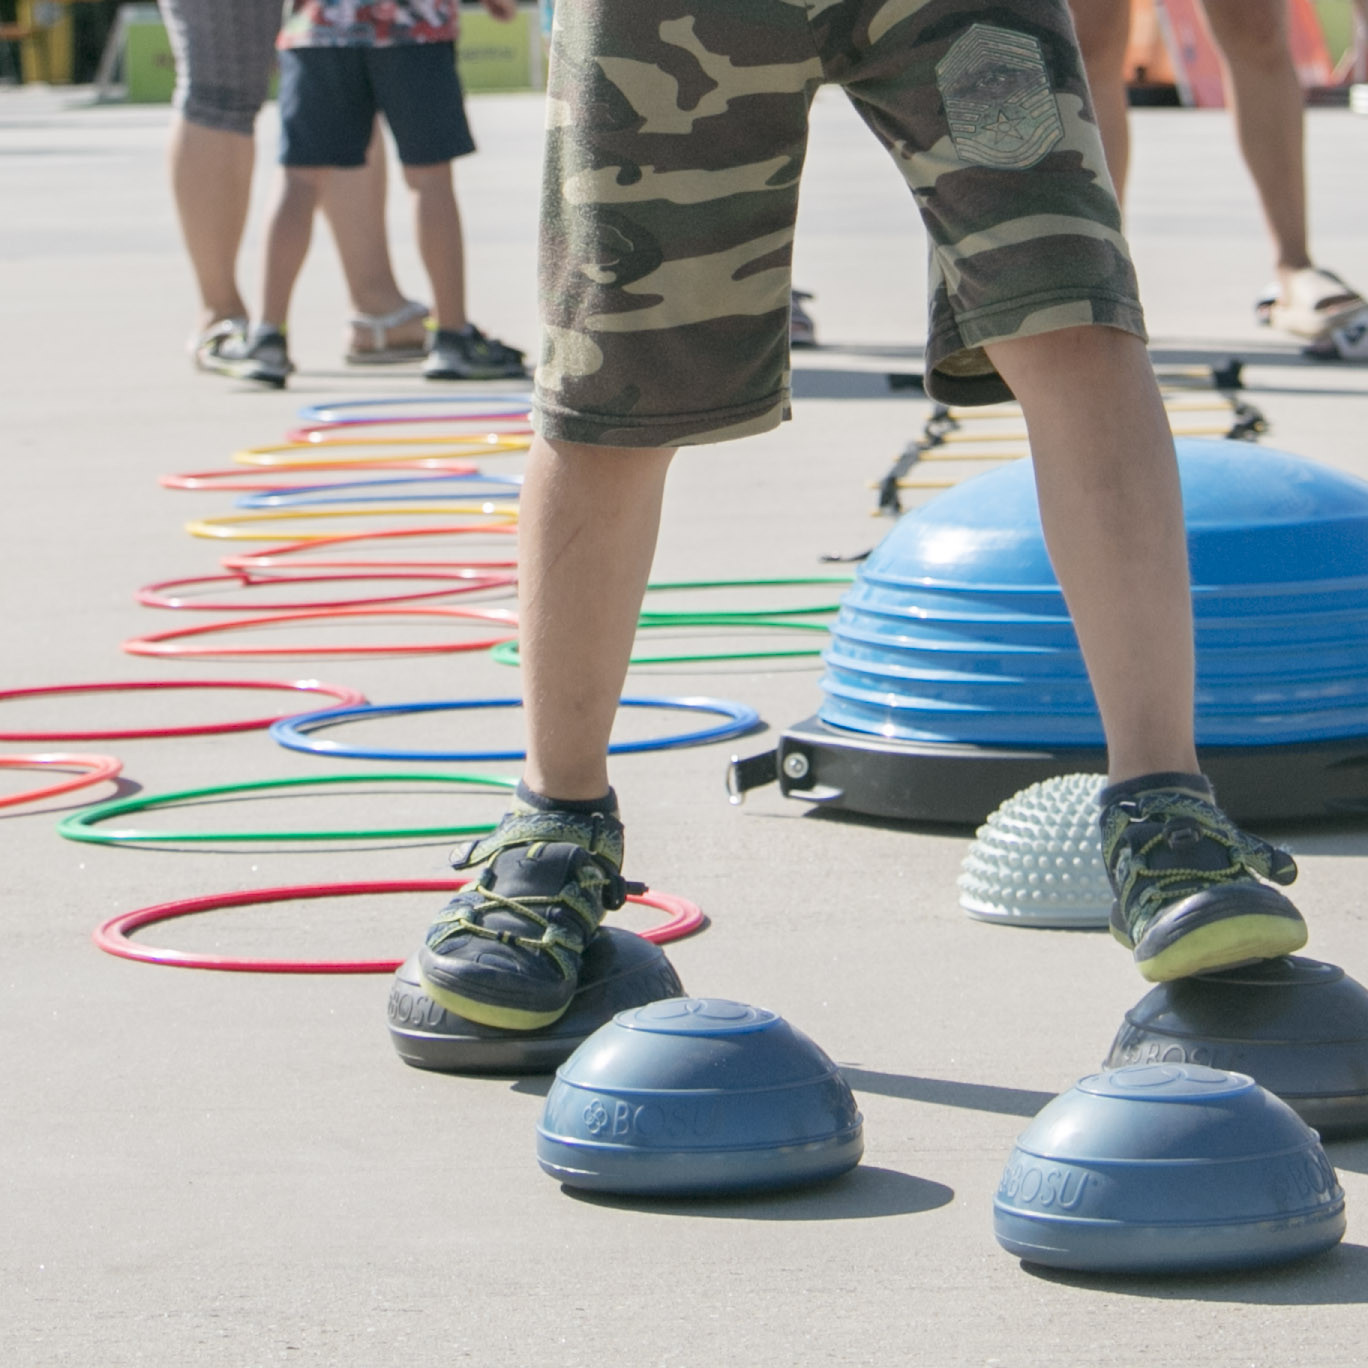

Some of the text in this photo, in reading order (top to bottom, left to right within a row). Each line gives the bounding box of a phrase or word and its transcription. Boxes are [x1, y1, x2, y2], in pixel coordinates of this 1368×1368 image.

[388, 991, 447, 1027] BOSU
[612, 1099, 720, 1137] BOSU
[1007, 1165, 1089, 1210] BOSU
